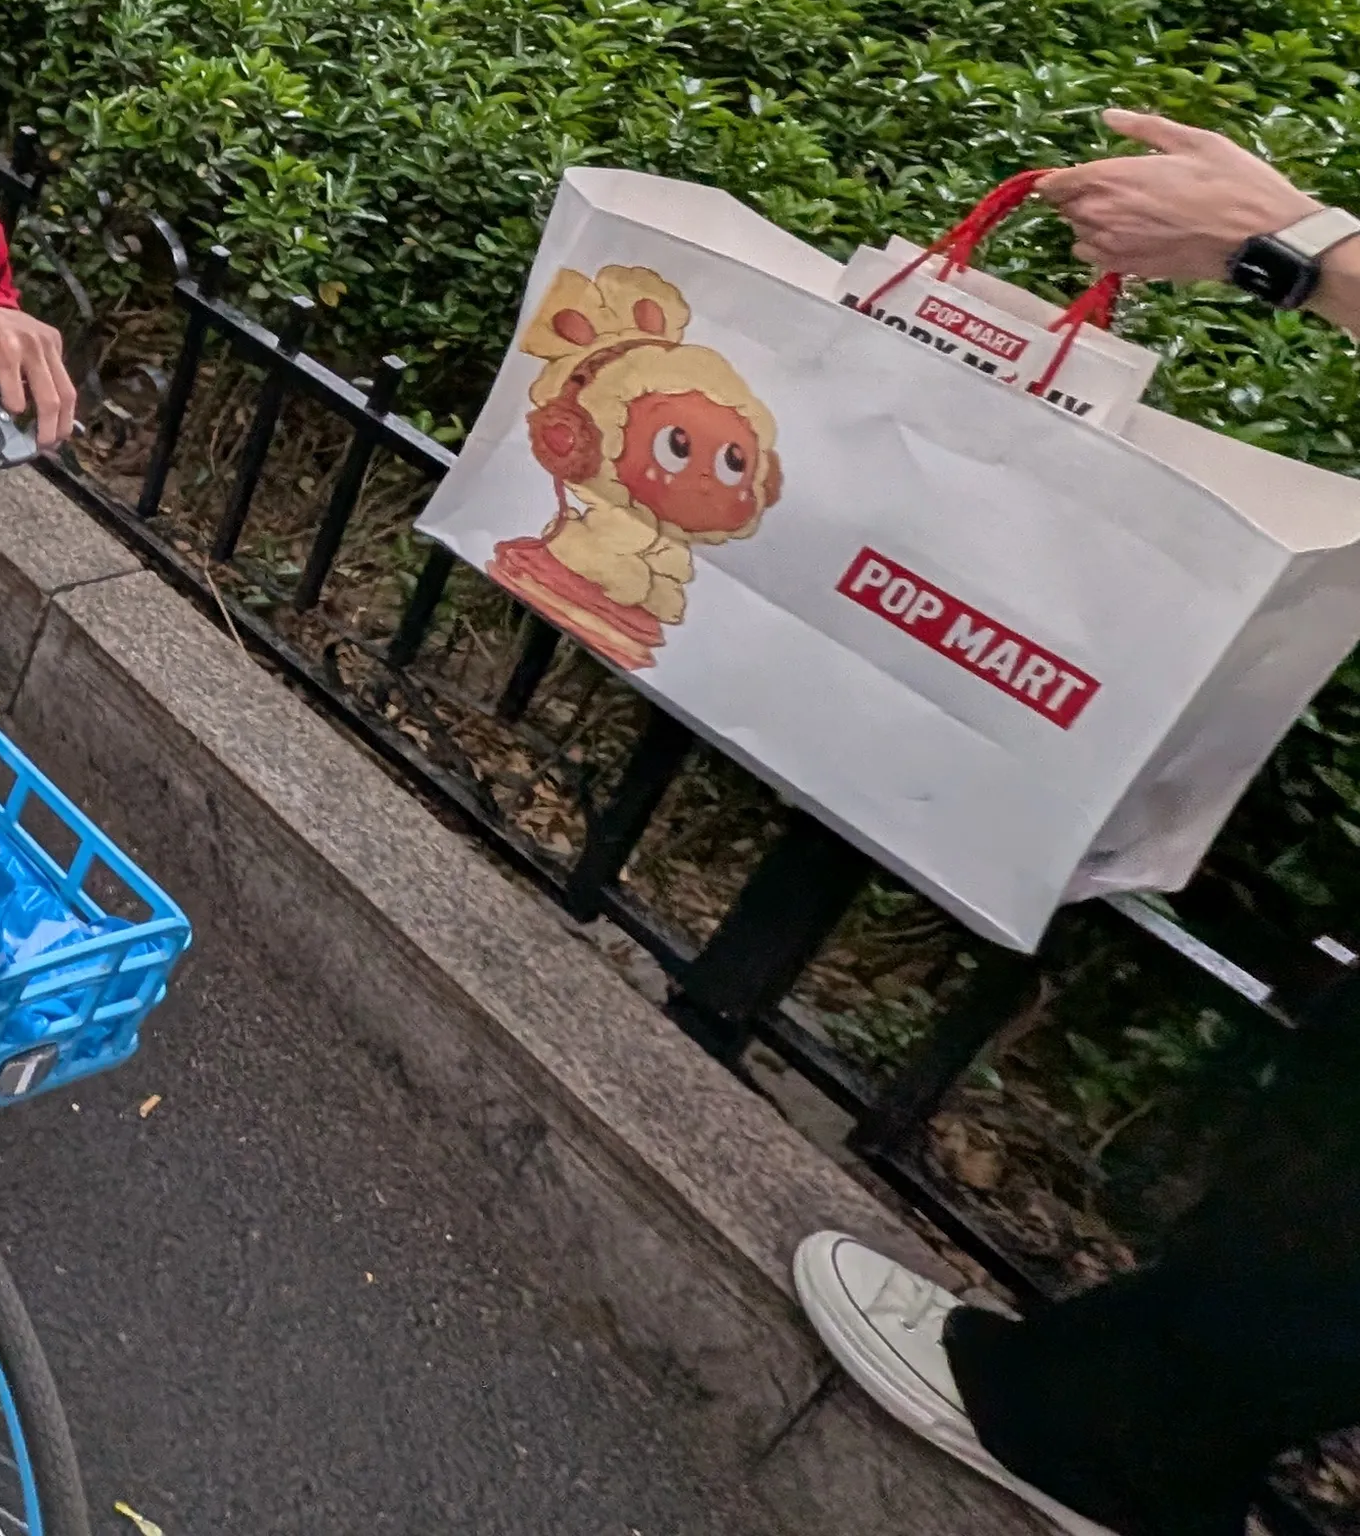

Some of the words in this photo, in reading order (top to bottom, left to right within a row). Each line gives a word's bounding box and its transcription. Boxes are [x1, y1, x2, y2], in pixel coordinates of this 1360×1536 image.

[922, 300, 964, 326] POP
[961, 321, 1022, 357] MART
[850, 559, 945, 625] POP
[940, 613, 1087, 712] MART
